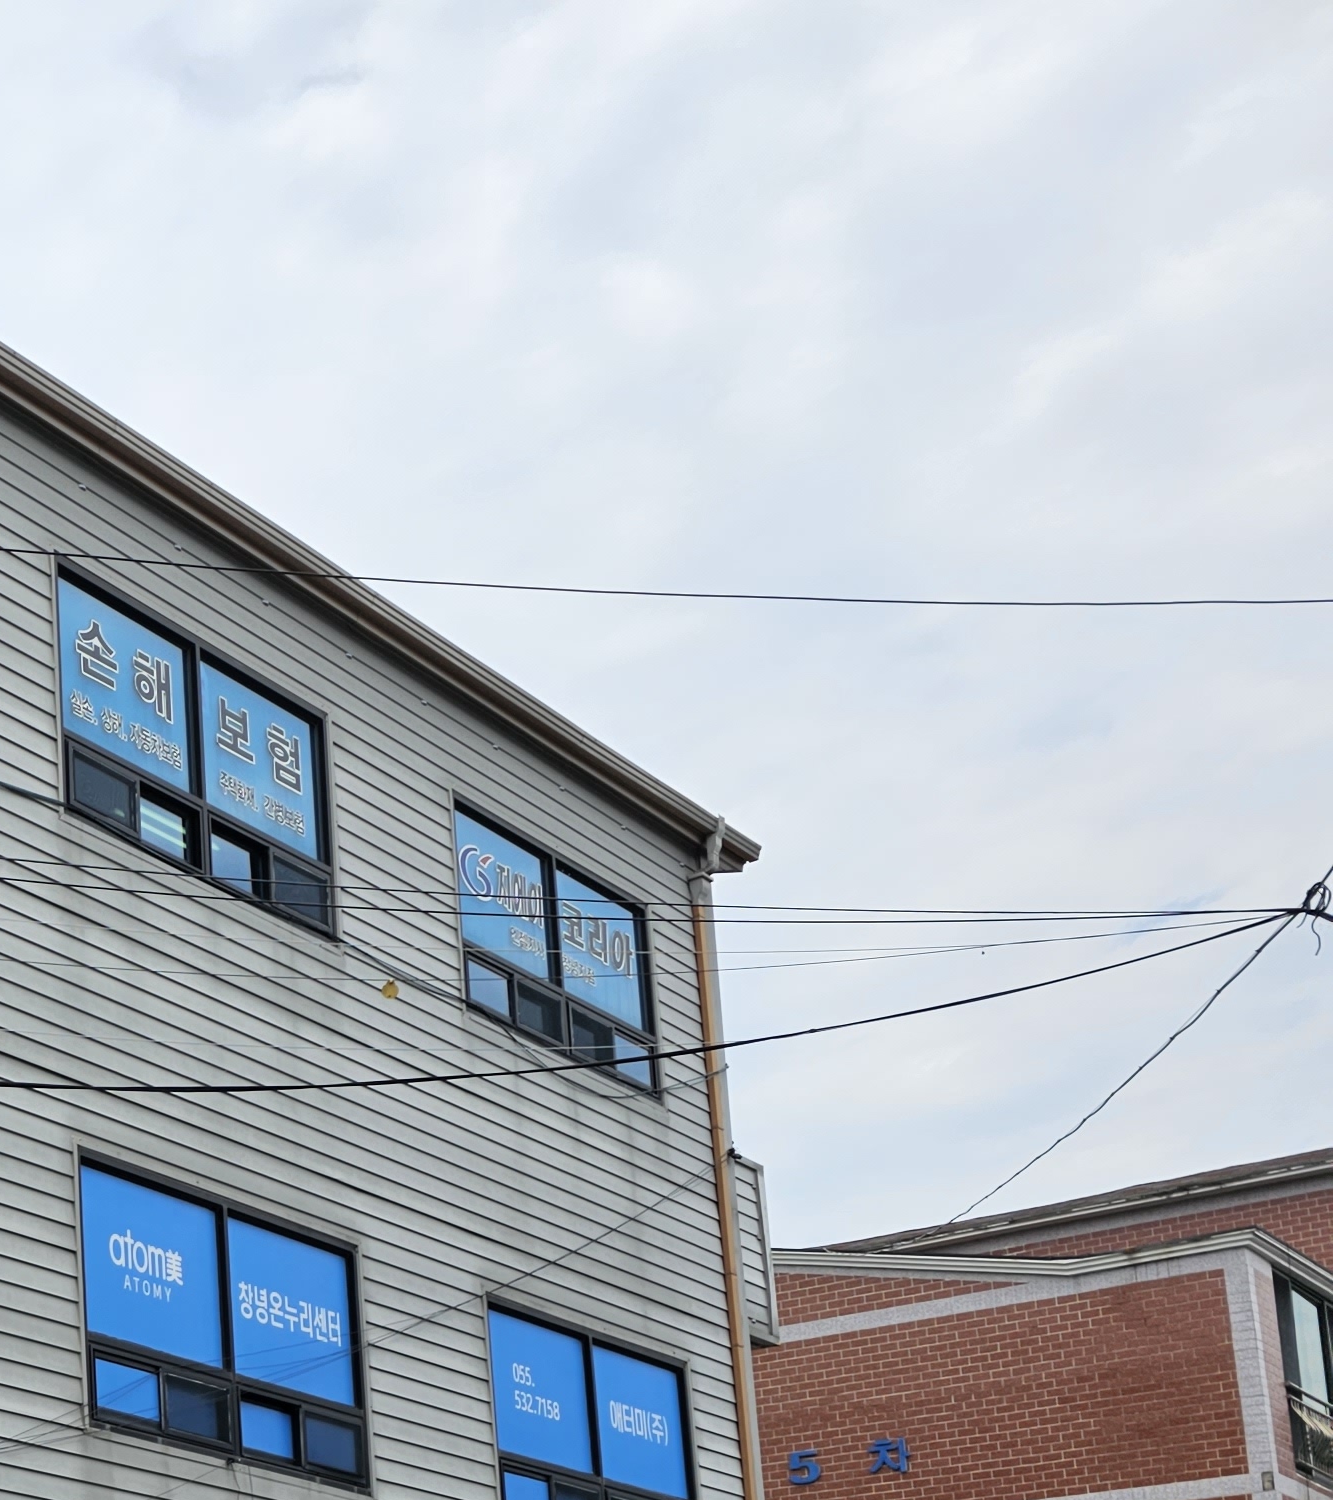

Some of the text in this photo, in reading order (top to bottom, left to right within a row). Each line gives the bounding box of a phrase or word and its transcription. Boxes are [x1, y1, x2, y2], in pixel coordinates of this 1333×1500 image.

[75, 619, 304, 795] 손해 보험
[123, 1274, 173, 1303] ATOMY
[238, 1281, 343, 1347] 창녕온누리센터
[514, 1390, 561, 1421] 532.7158
[609, 1400, 669, 1447] 애터미(주)
